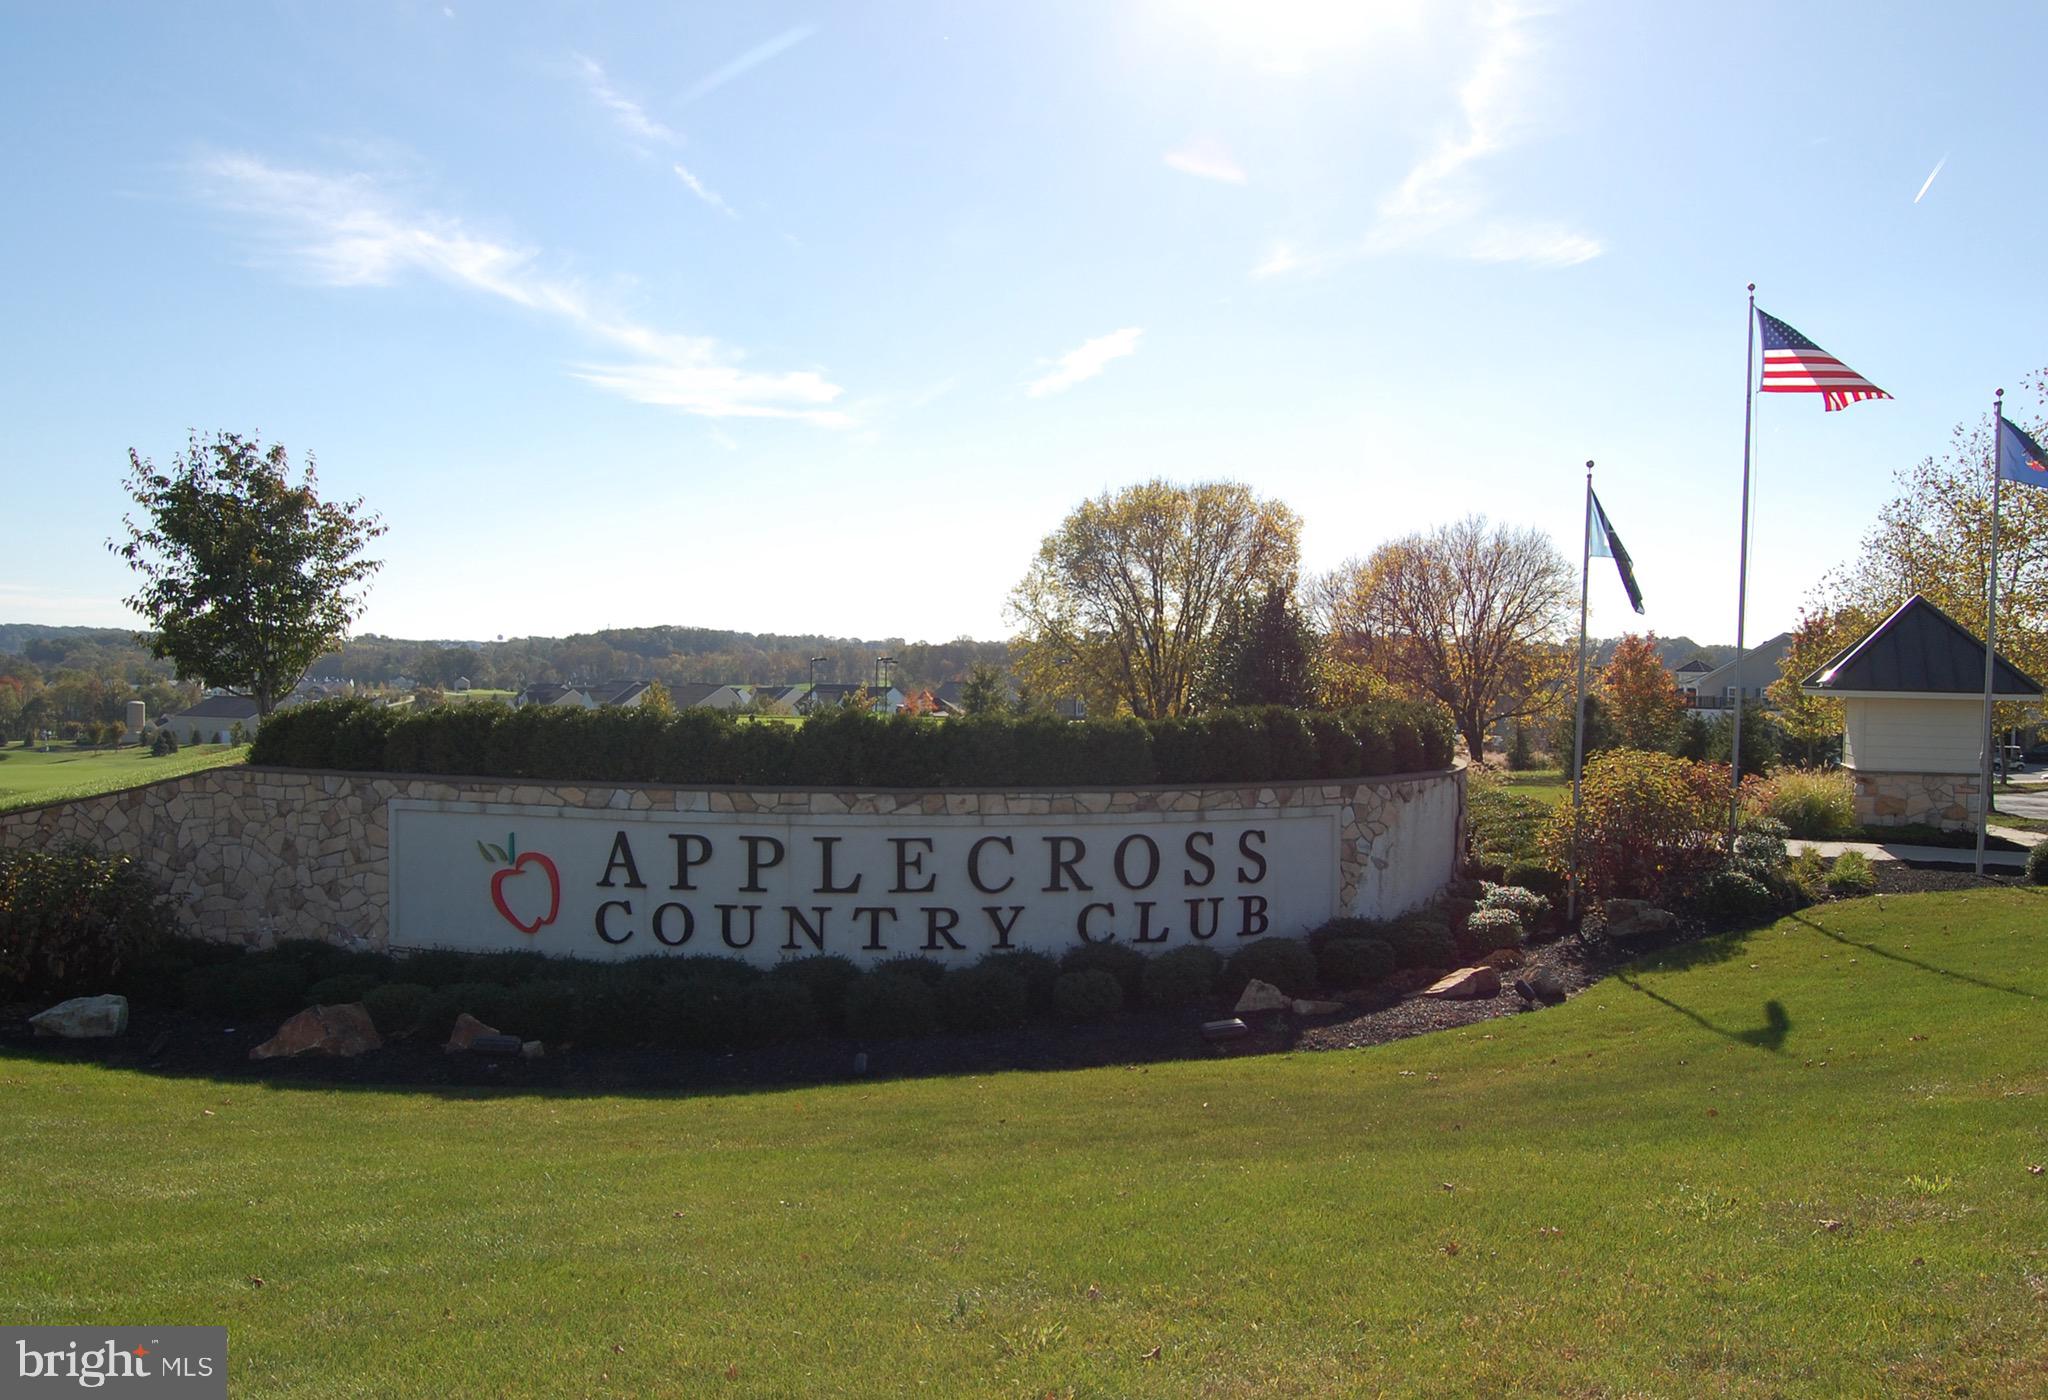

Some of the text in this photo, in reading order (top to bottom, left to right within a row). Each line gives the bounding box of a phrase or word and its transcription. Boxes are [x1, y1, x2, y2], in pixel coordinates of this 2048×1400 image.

[596, 830, 1268, 894] APPLECROSS
[595, 895, 1269, 950] COUNTRY CLUB
